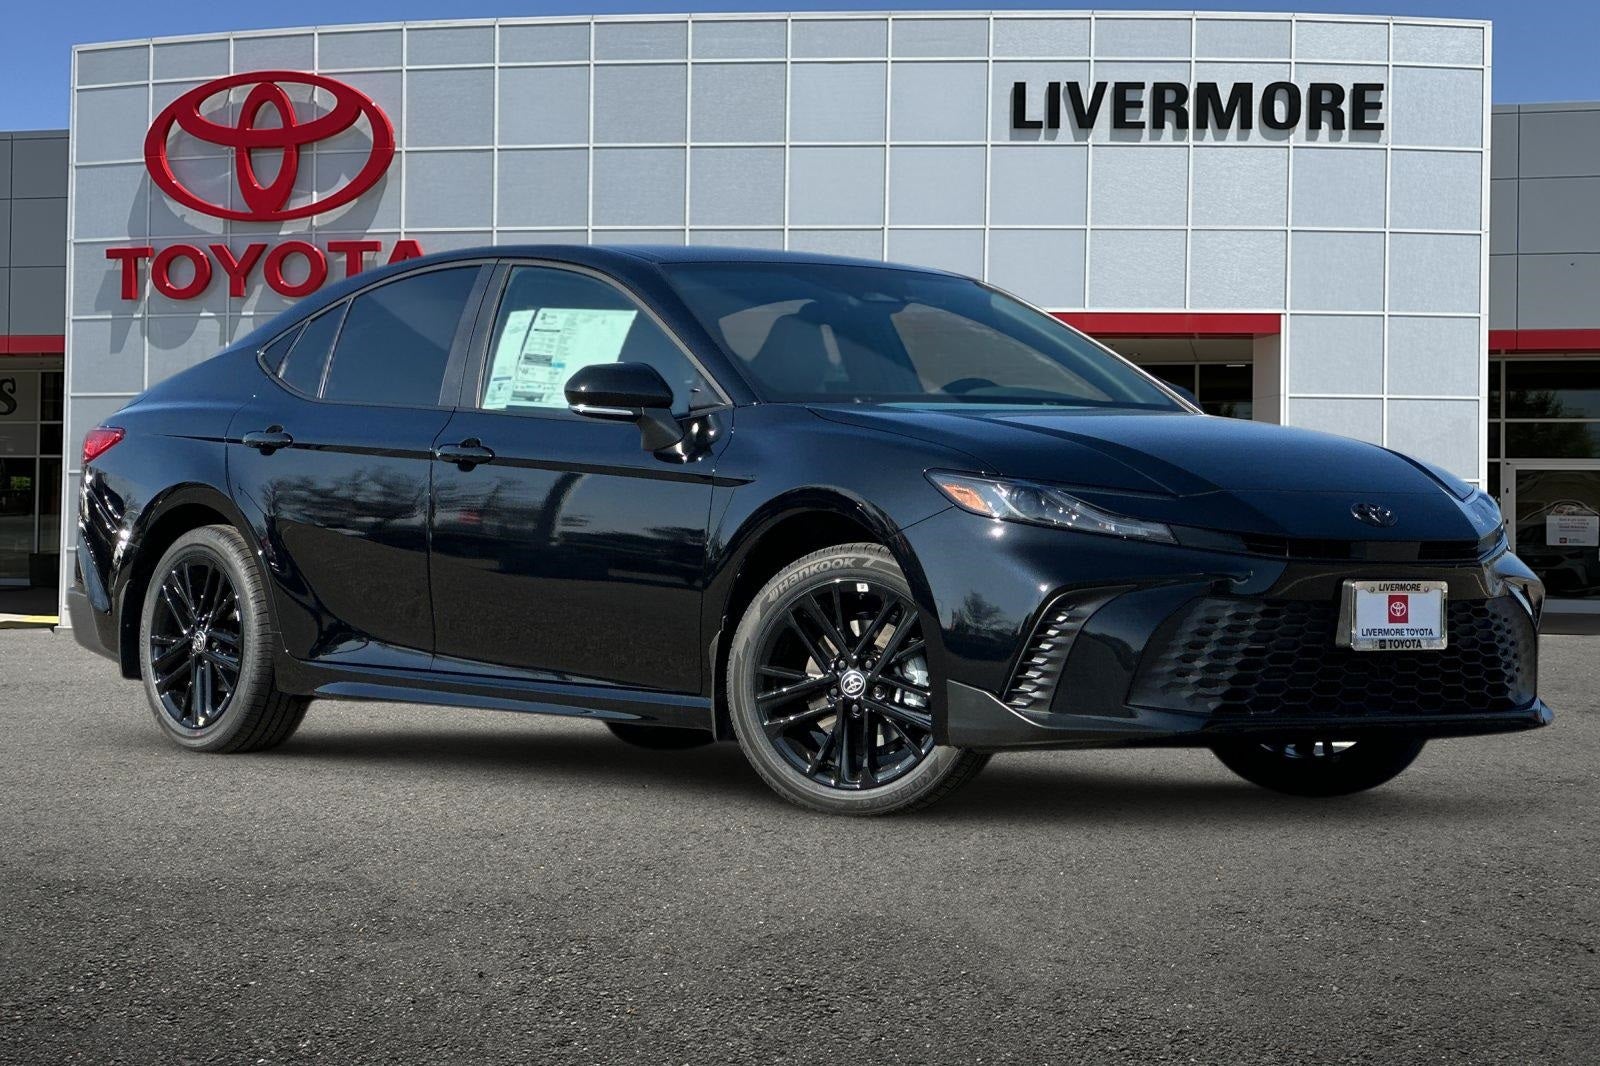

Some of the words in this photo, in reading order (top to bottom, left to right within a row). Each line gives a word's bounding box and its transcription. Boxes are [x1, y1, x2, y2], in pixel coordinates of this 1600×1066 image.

[1013, 81, 1385, 131] LIVERMORE
[1378, 583, 1422, 592] LIVERMORE
[1361, 628, 1405, 637] LIVERMORE
[1406, 628, 1434, 637] TOYOTA
[1388, 639, 1422, 649] TOYOTA
